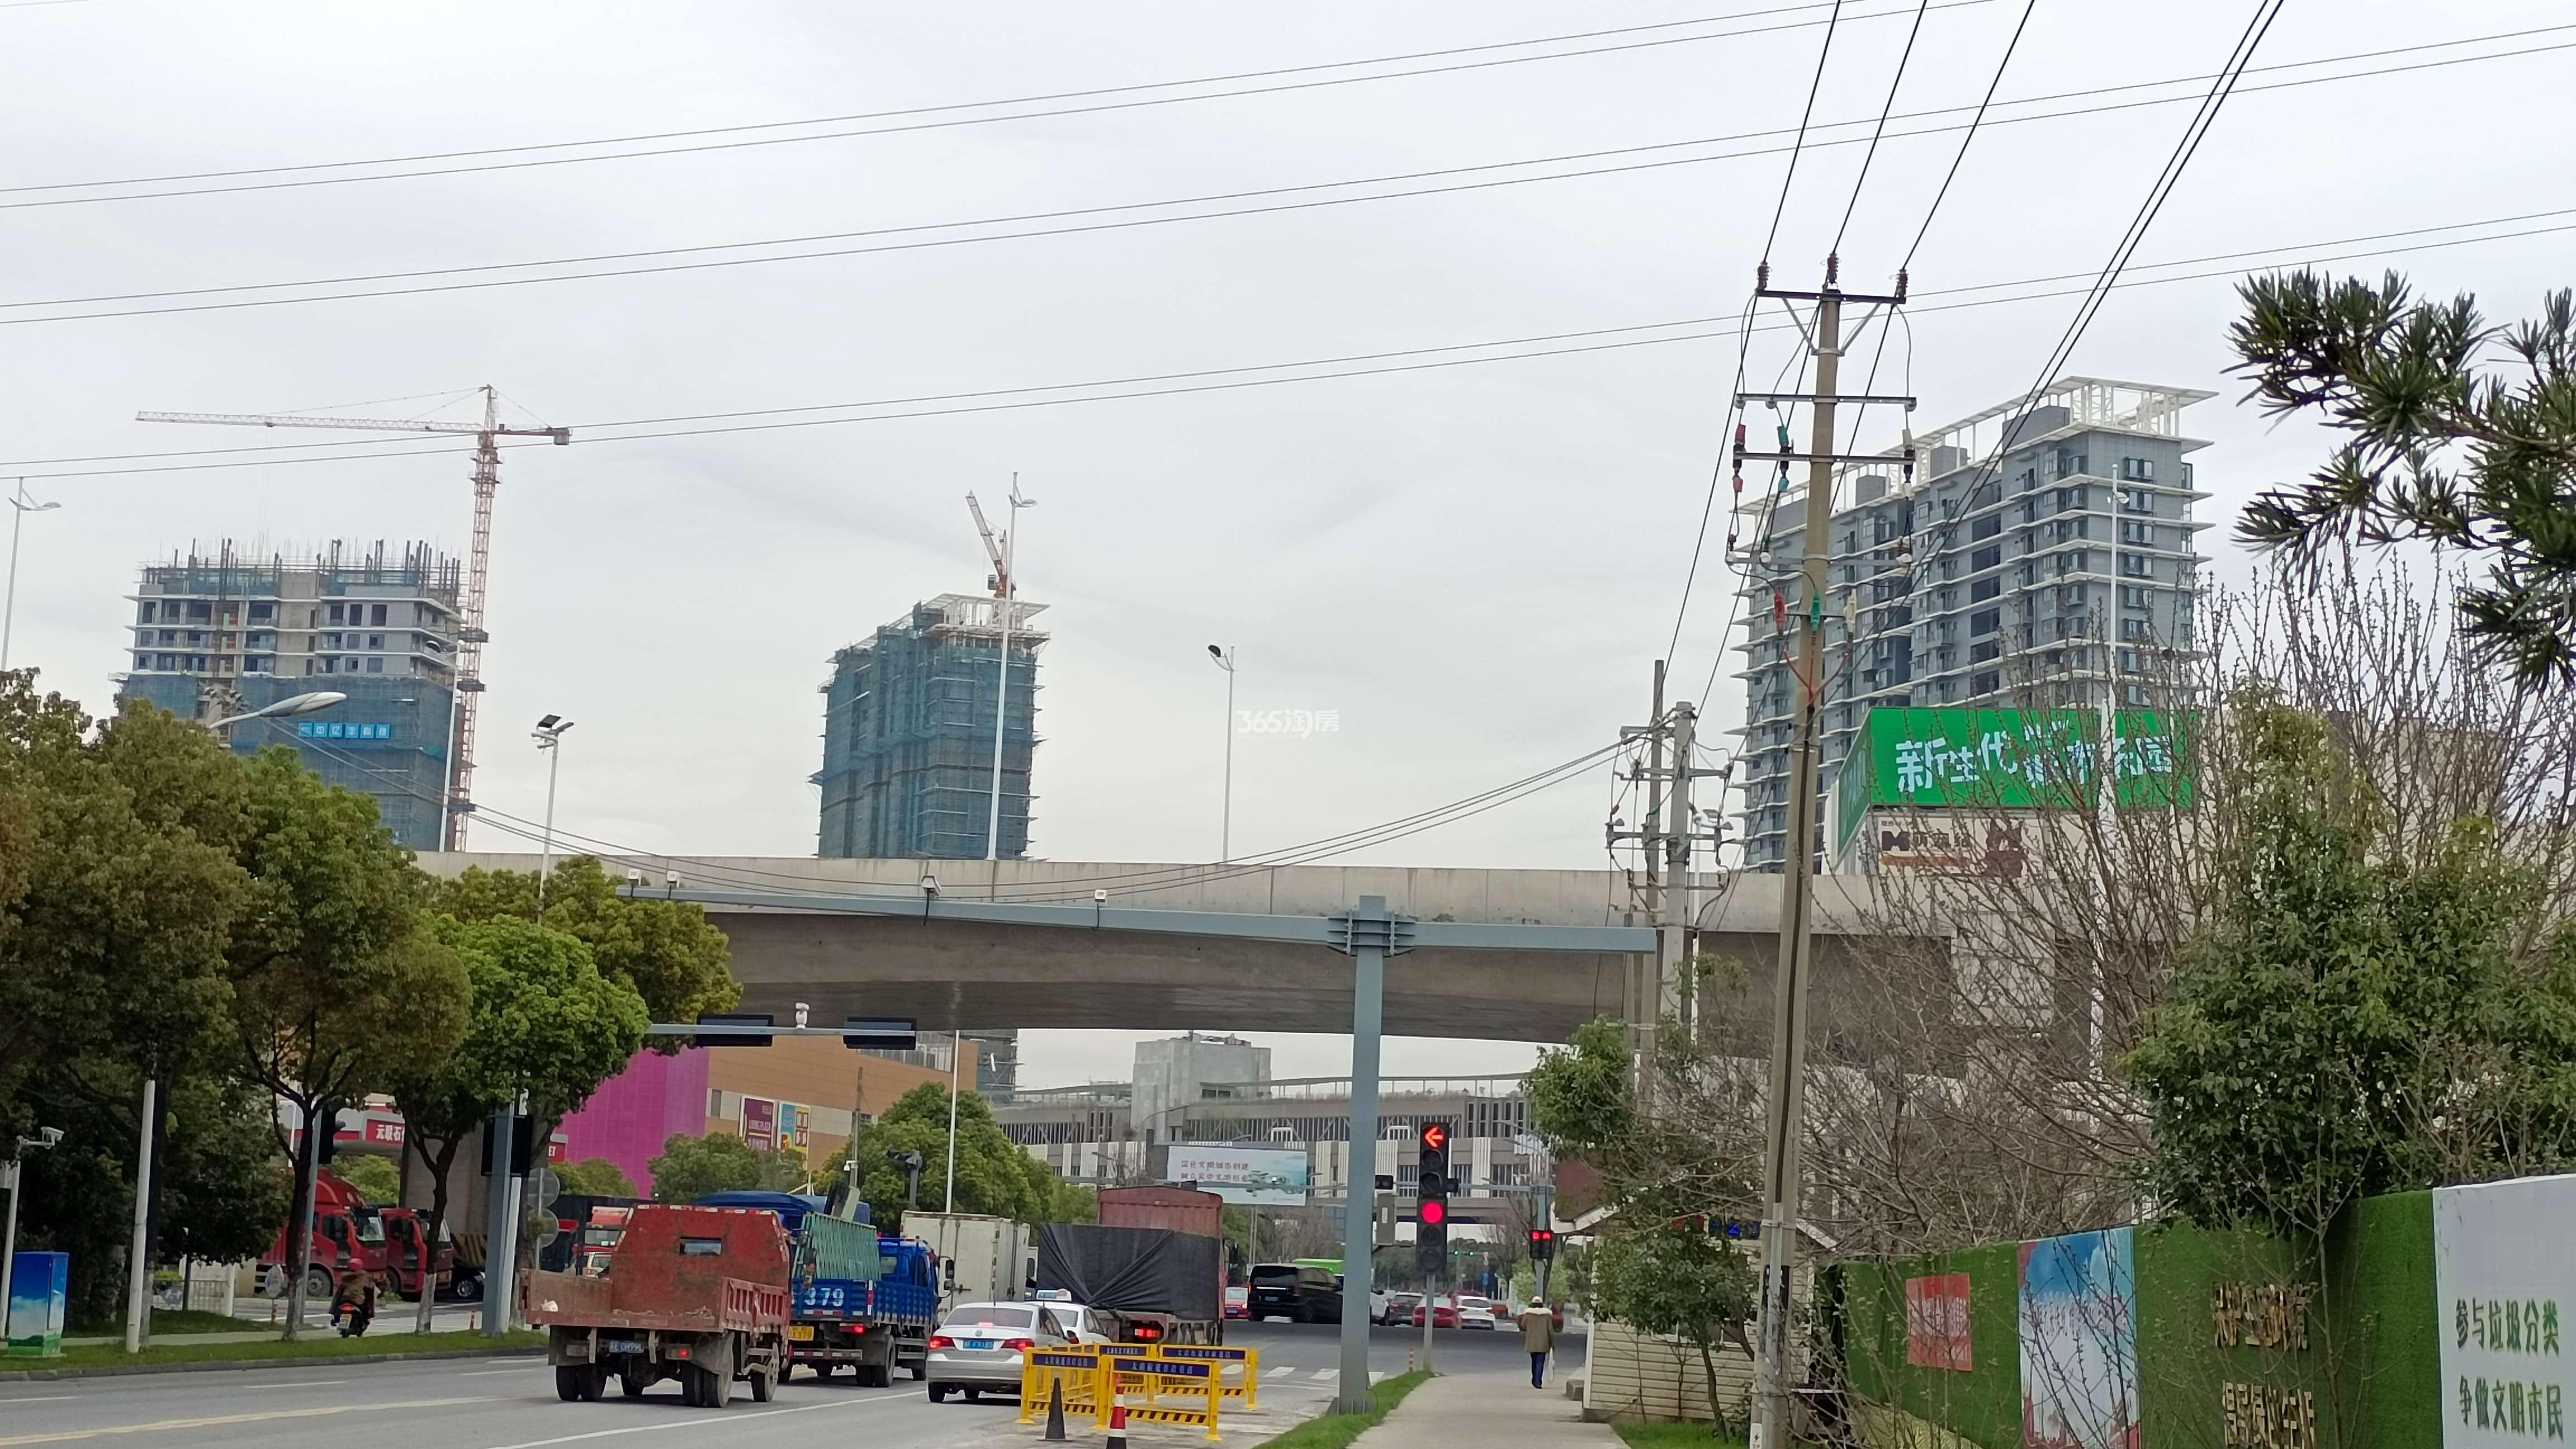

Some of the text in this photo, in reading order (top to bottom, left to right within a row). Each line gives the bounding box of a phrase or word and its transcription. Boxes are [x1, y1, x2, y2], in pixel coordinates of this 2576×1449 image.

[376, 1124, 404, 1143] 元联石
[792, 1287, 844, 1306] 379
[2456, 1297, 2560, 1357] 参与垃圾分类
[2459, 1374, 2564, 1442] 争做文明市民
